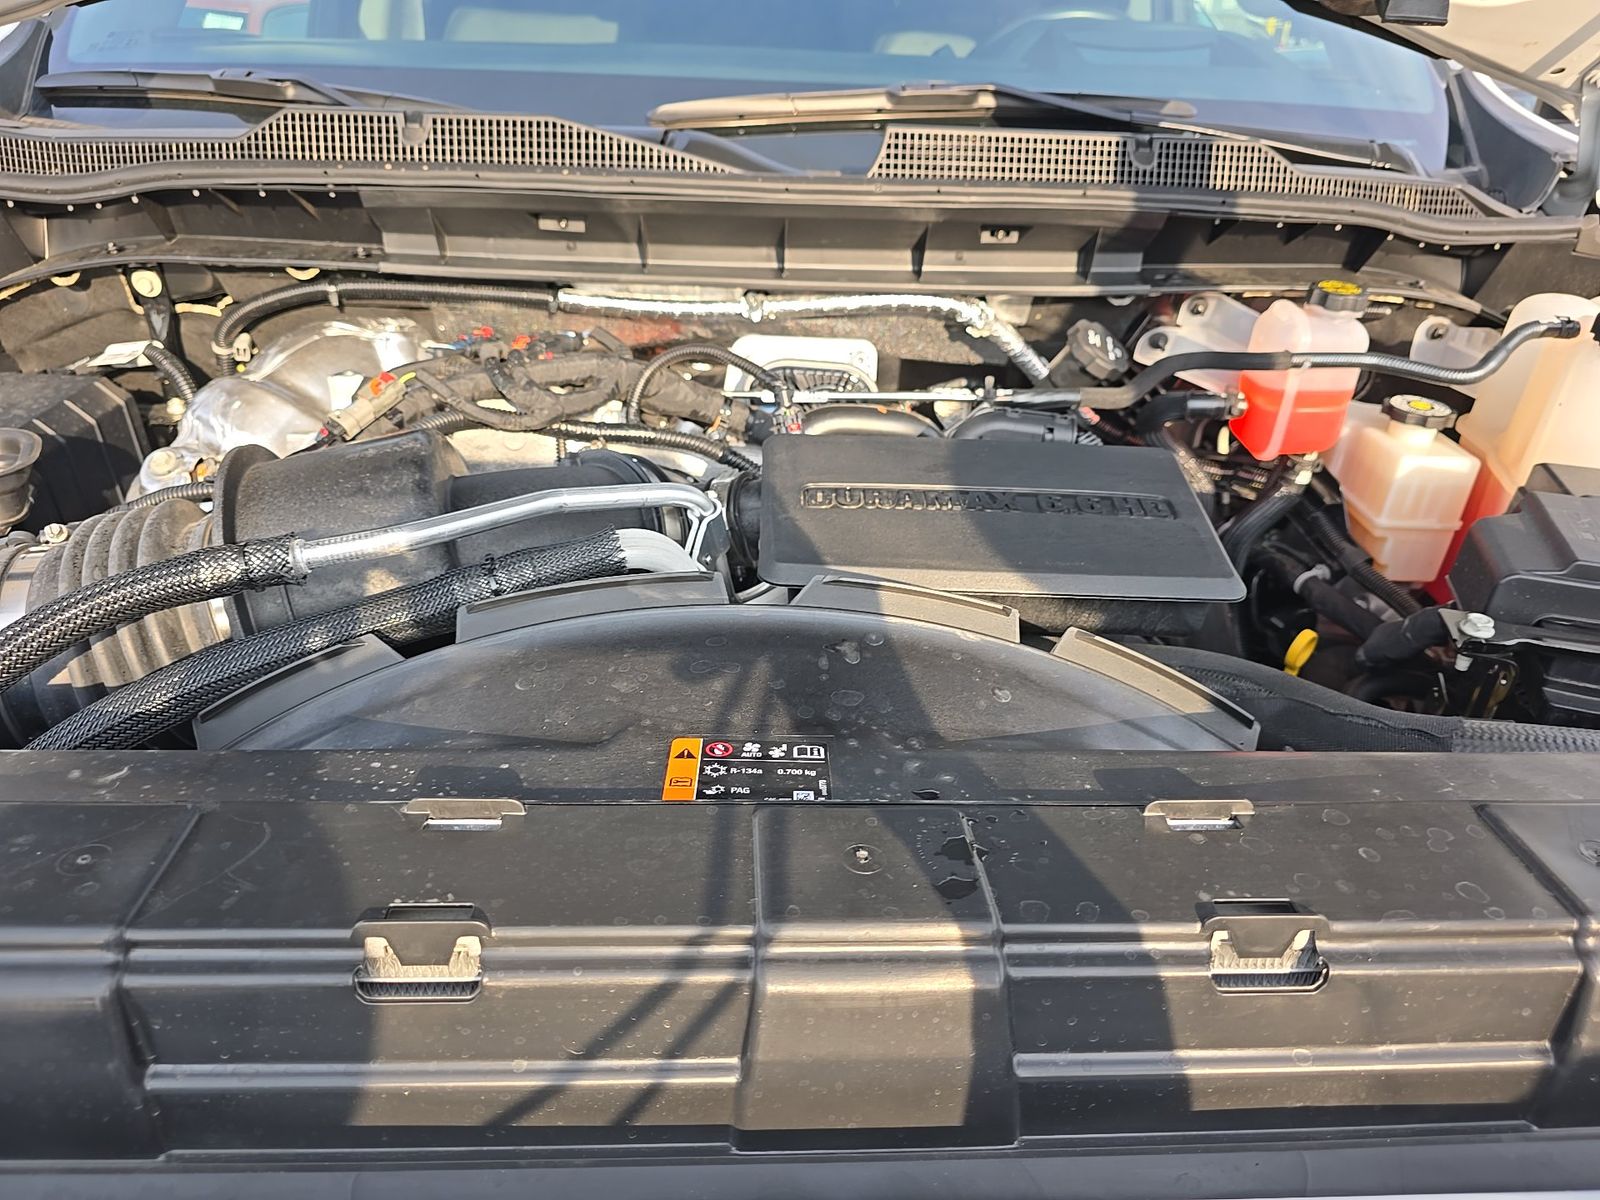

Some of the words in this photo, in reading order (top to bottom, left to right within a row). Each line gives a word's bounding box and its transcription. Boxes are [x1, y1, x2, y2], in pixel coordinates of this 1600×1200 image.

[805, 487, 1019, 512] DURAMAX
[730, 767, 763, 775] R-134a
[804, 769, 817, 777] kg
[730, 786, 751, 794] PAG
